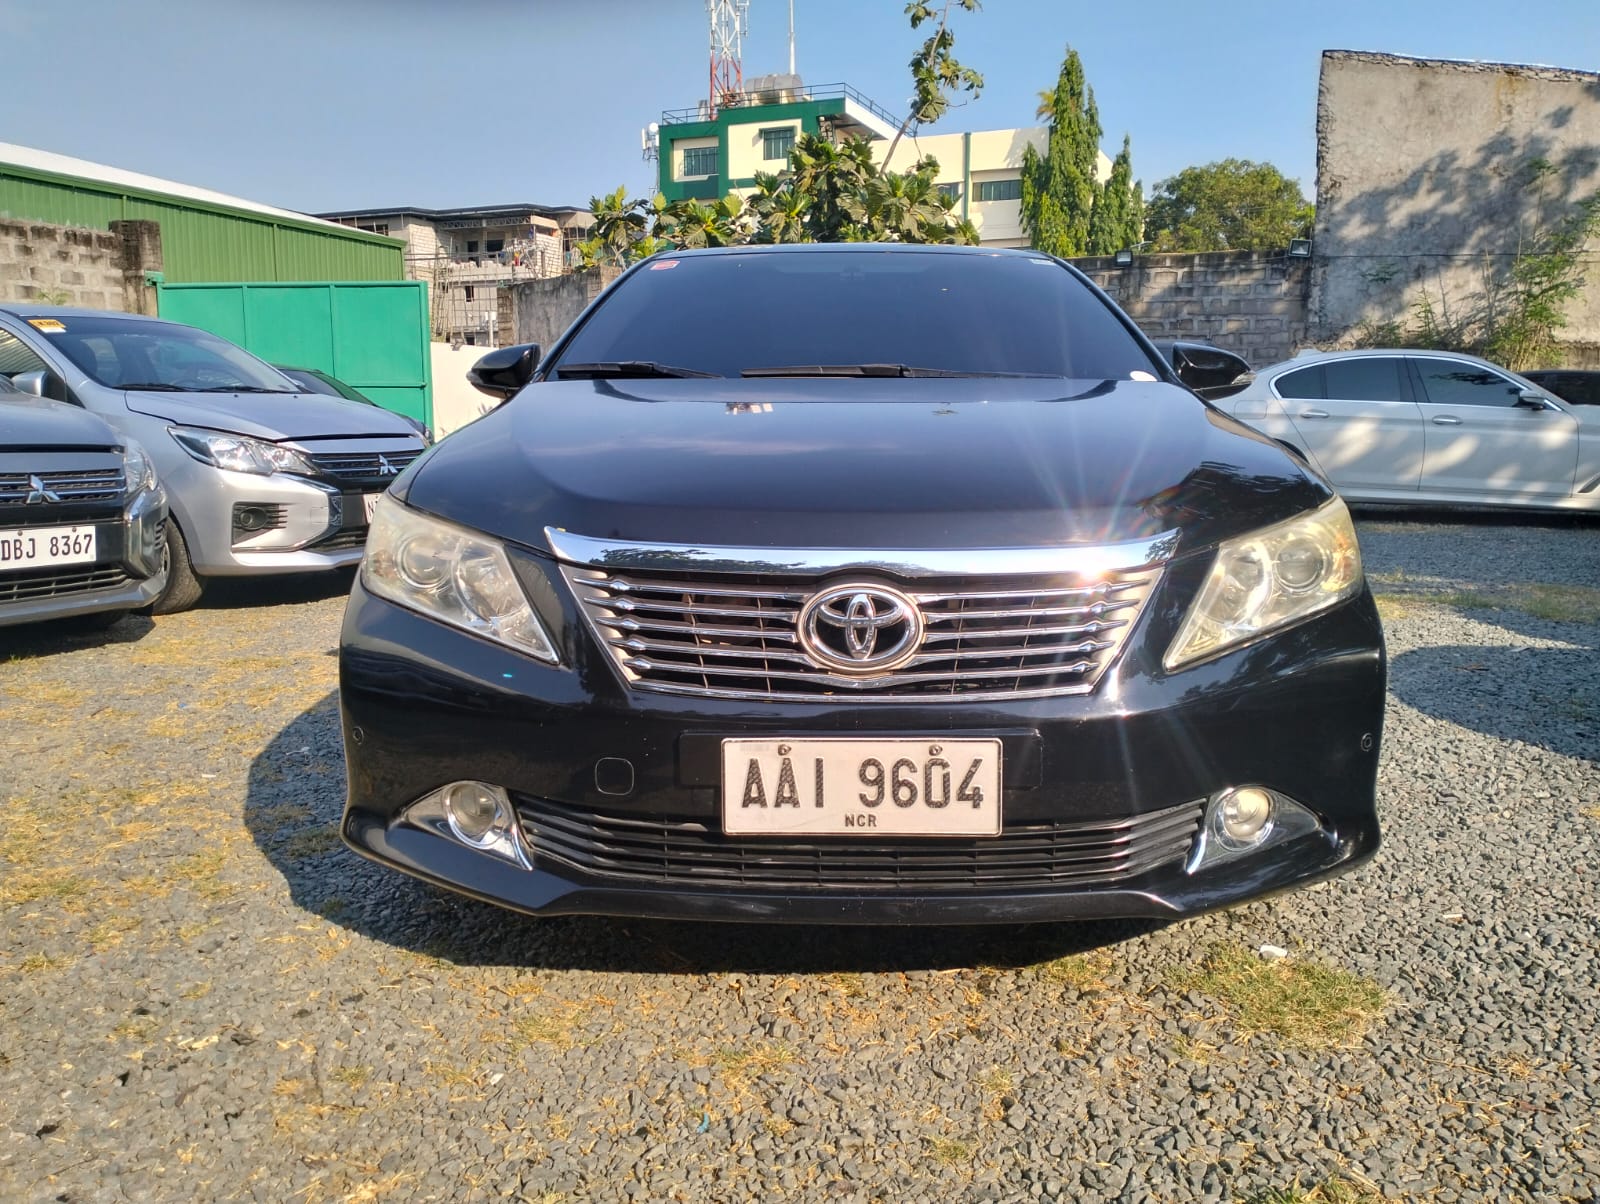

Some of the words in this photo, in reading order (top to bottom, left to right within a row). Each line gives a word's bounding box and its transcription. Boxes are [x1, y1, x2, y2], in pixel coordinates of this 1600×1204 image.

[0, 538, 36, 561] DBJ
[49, 534, 93, 557] 8367
[741, 757, 825, 809] AAI
[858, 757, 984, 809] 9604
[844, 813, 878, 828] NCR
